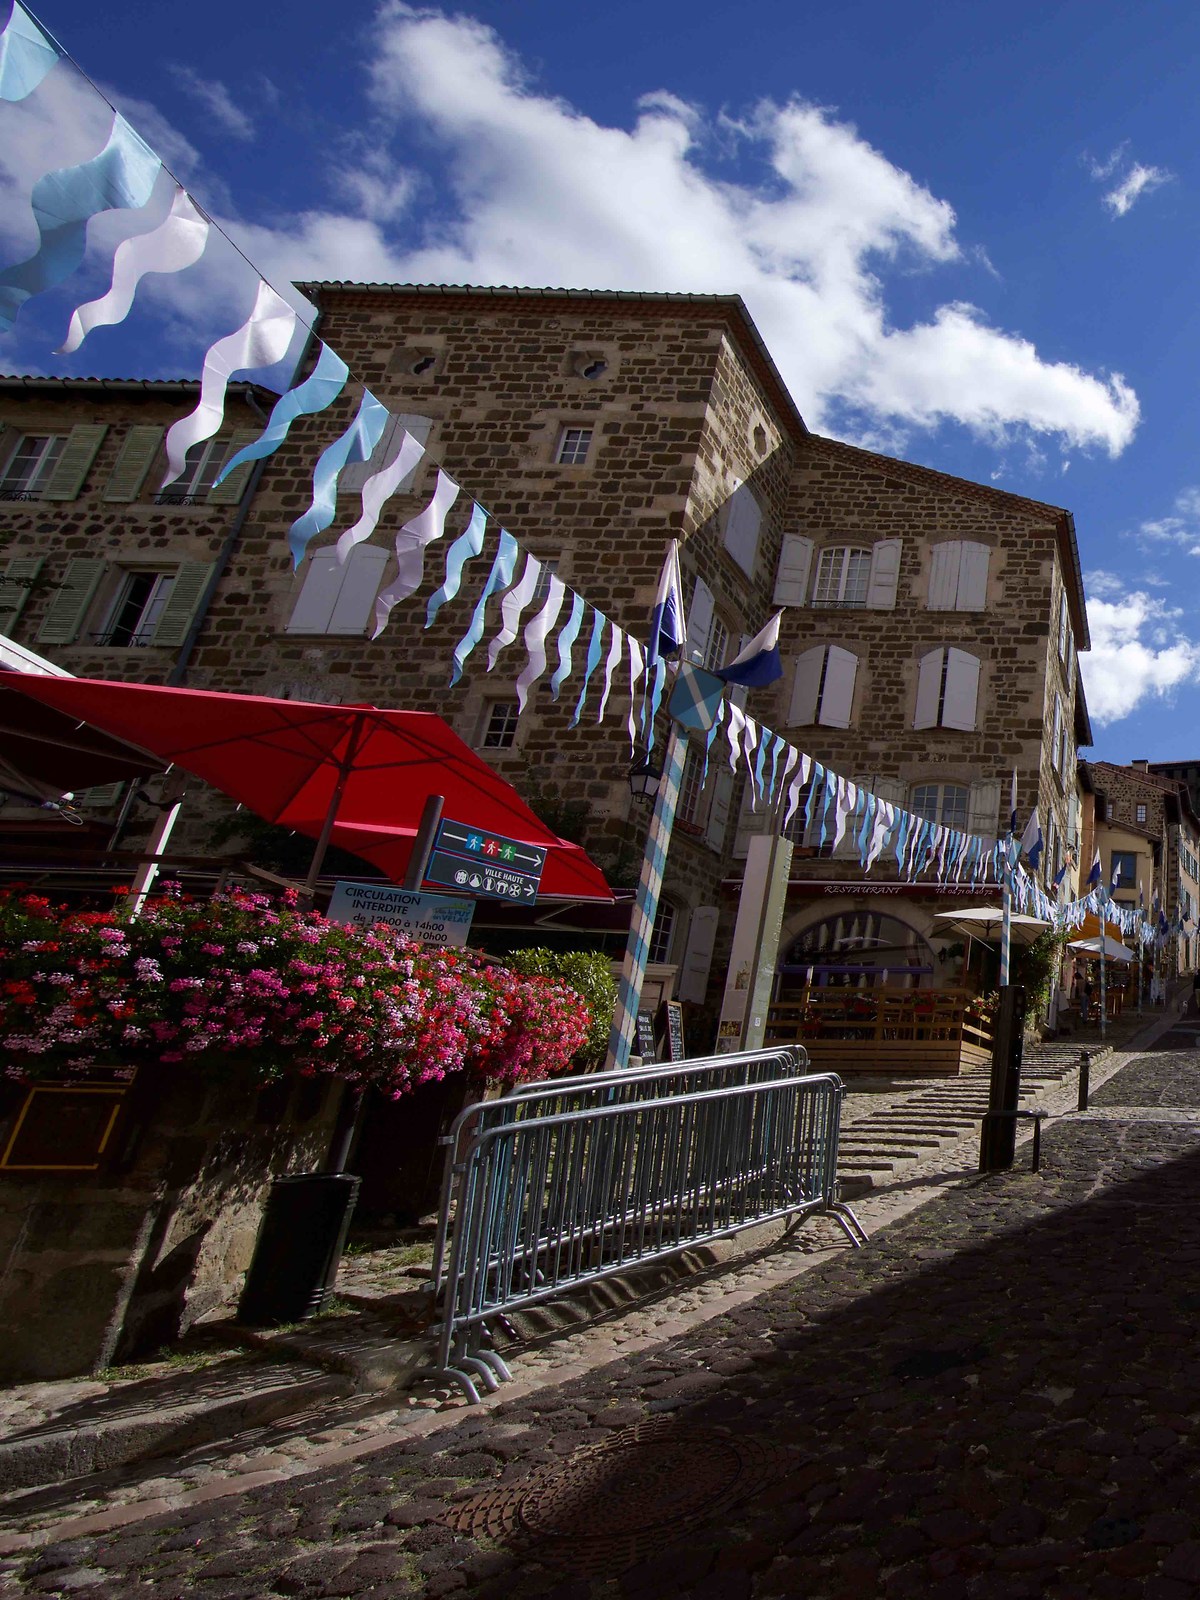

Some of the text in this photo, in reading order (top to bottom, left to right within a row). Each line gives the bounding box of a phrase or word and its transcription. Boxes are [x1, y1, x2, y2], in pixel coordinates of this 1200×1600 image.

[485, 868, 524, 884] VILLE HAUTE
[345, 887, 422, 905] CIRCULATION
[824, 885, 903, 895] RESTAURANT
[352, 899, 409, 915] INTERDITE
[370, 915, 402, 926] 12h00
[404, 920, 410, 928] à
[415, 921, 445, 932] 14h00
[418, 931, 448, 942] 10h00
